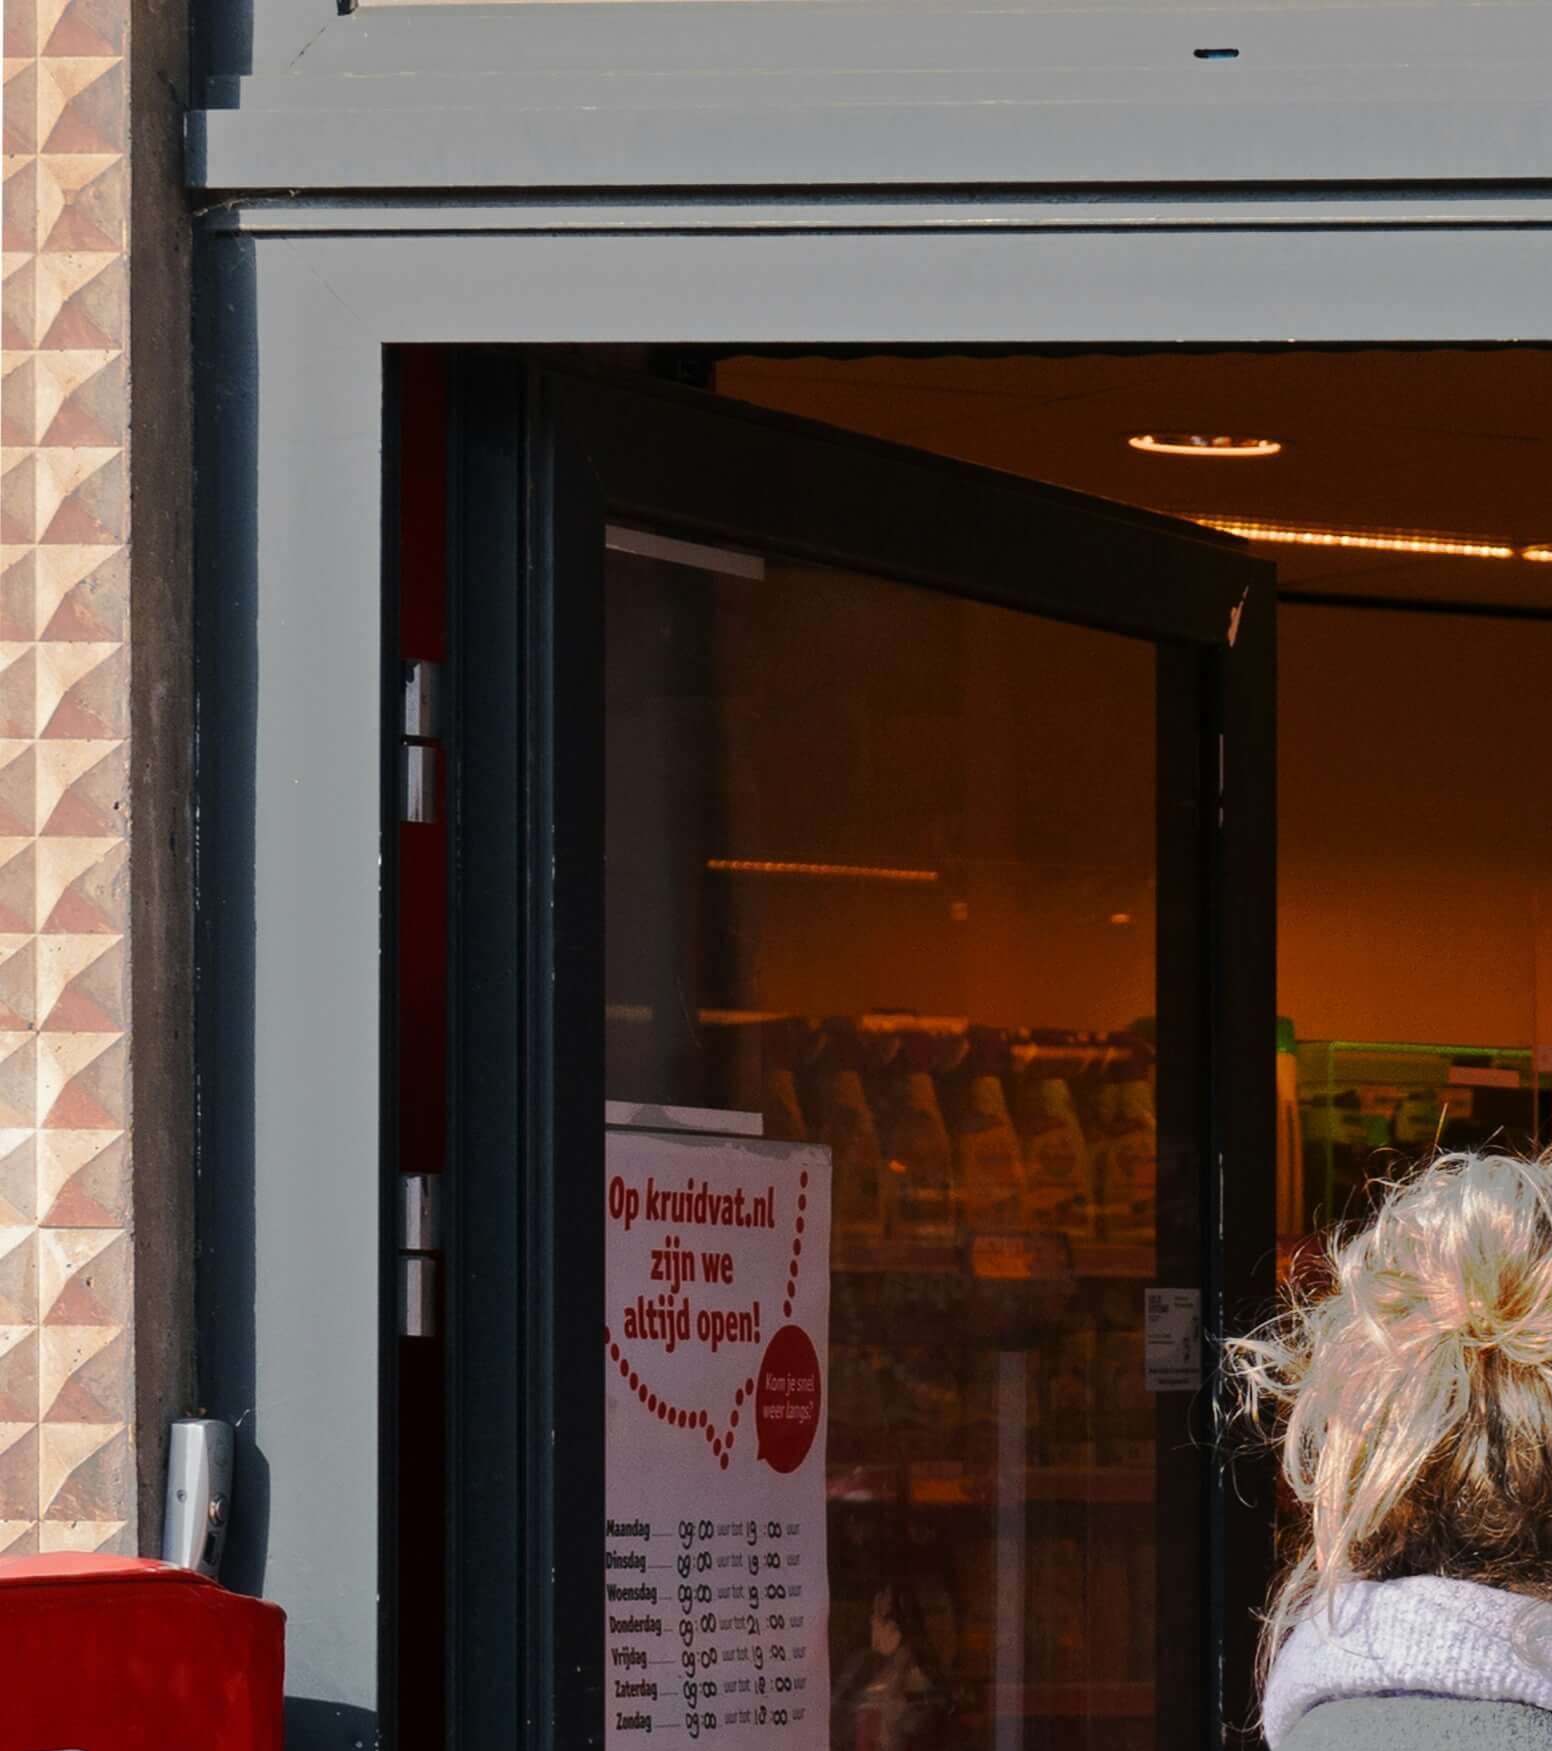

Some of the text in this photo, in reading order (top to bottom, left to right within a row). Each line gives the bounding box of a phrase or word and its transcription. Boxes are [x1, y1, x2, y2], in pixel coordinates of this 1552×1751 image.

[609, 1175, 775, 1231] Op kruidvat.nl
[651, 1235, 733, 1294] zijn we
[624, 1294, 760, 1353] altijd open!
[606, 1518, 650, 1541] Maandag
[606, 1551, 646, 1573] Dinsdag
[607, 1583, 657, 1604] Woensdag
[610, 1615, 662, 1636] Donderdag
[612, 1646, 646, 1670] Vrijdag
[615, 1679, 657, 1700] Zaterdag
[616, 1712, 651, 1733] Zondag
